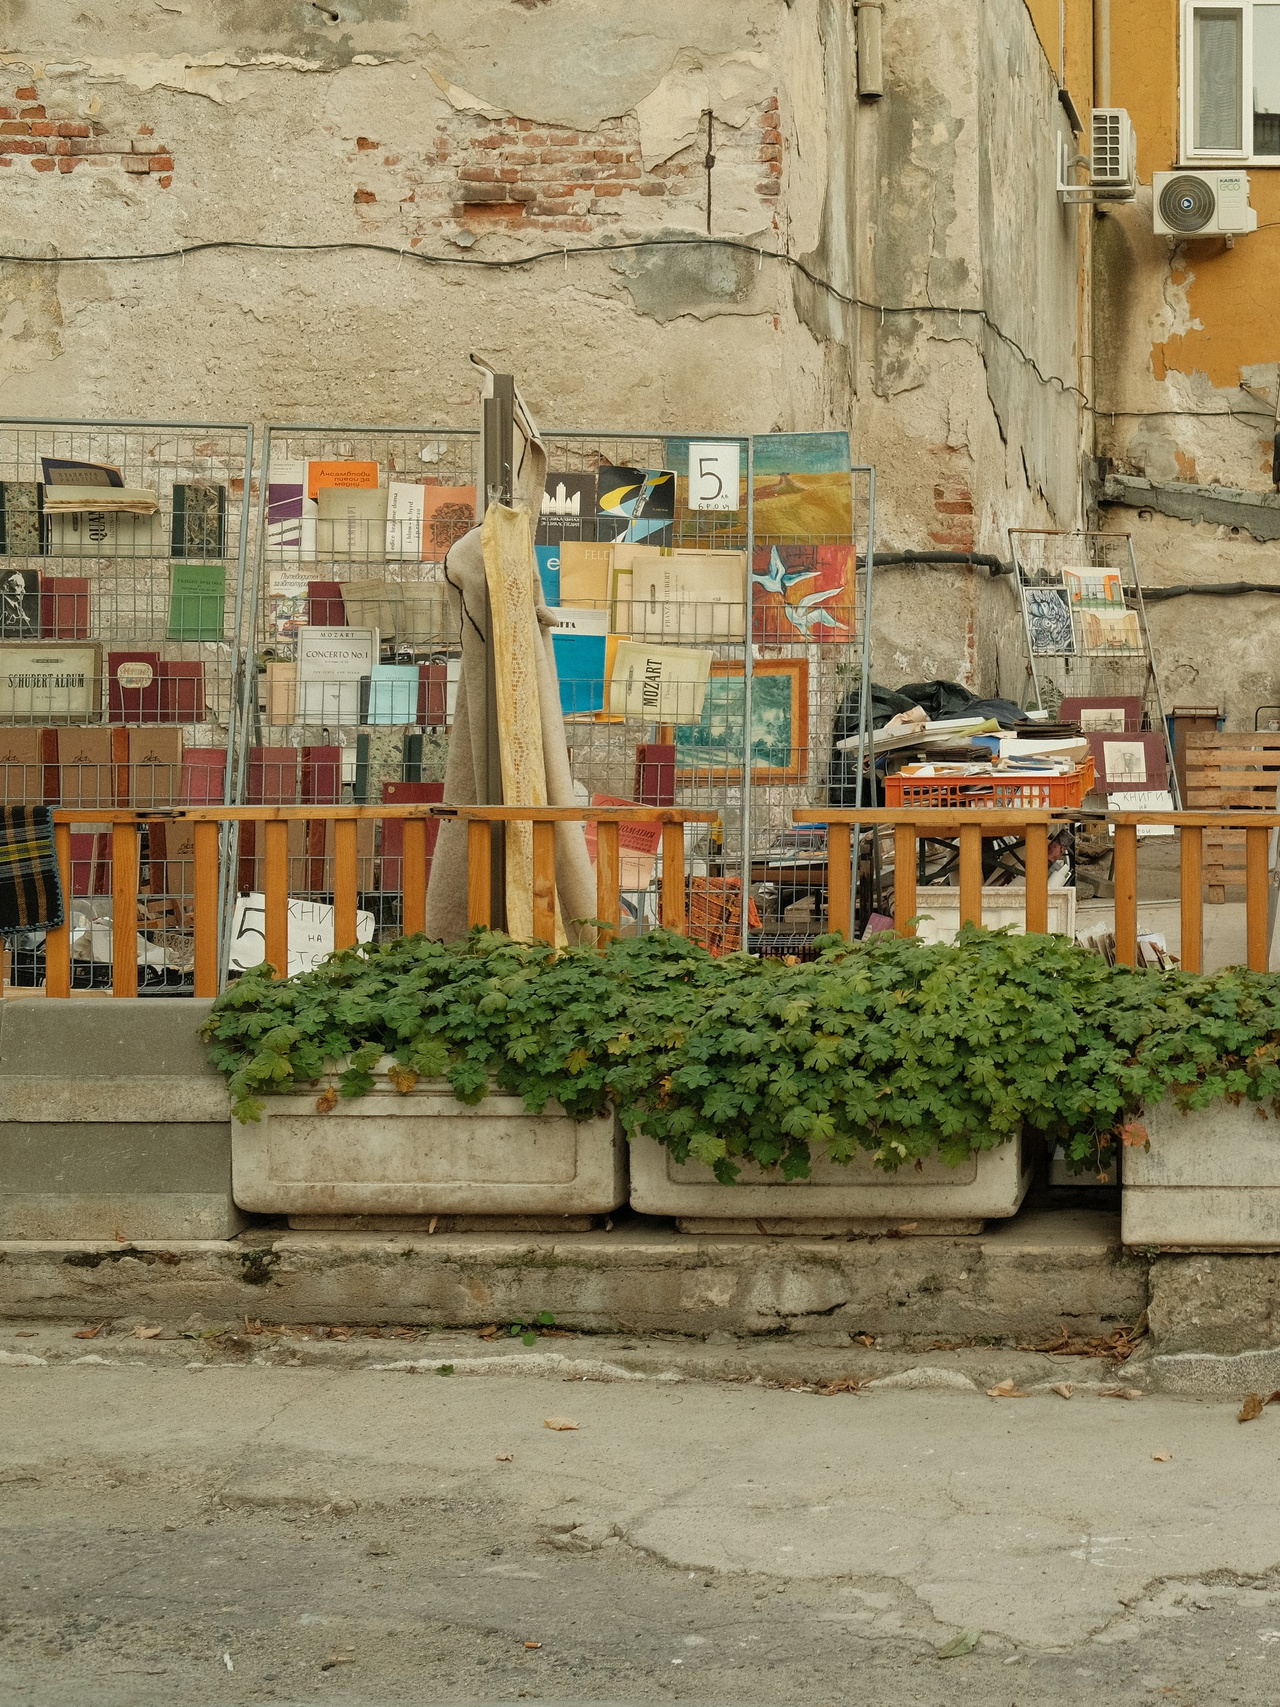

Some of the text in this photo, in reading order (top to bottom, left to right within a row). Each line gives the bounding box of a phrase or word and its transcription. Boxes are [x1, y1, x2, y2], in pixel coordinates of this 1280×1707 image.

[698, 457, 723, 501] 5
[306, 650, 350, 659] CONCERTO
[8, 673, 85, 688] SCHUBERT ALBUM
[643, 658, 662, 708] MOZART
[1123, 791, 1164, 802] КНИГИ
[288, 901, 369, 932] КНИИ
[308, 934, 323, 943] НА
